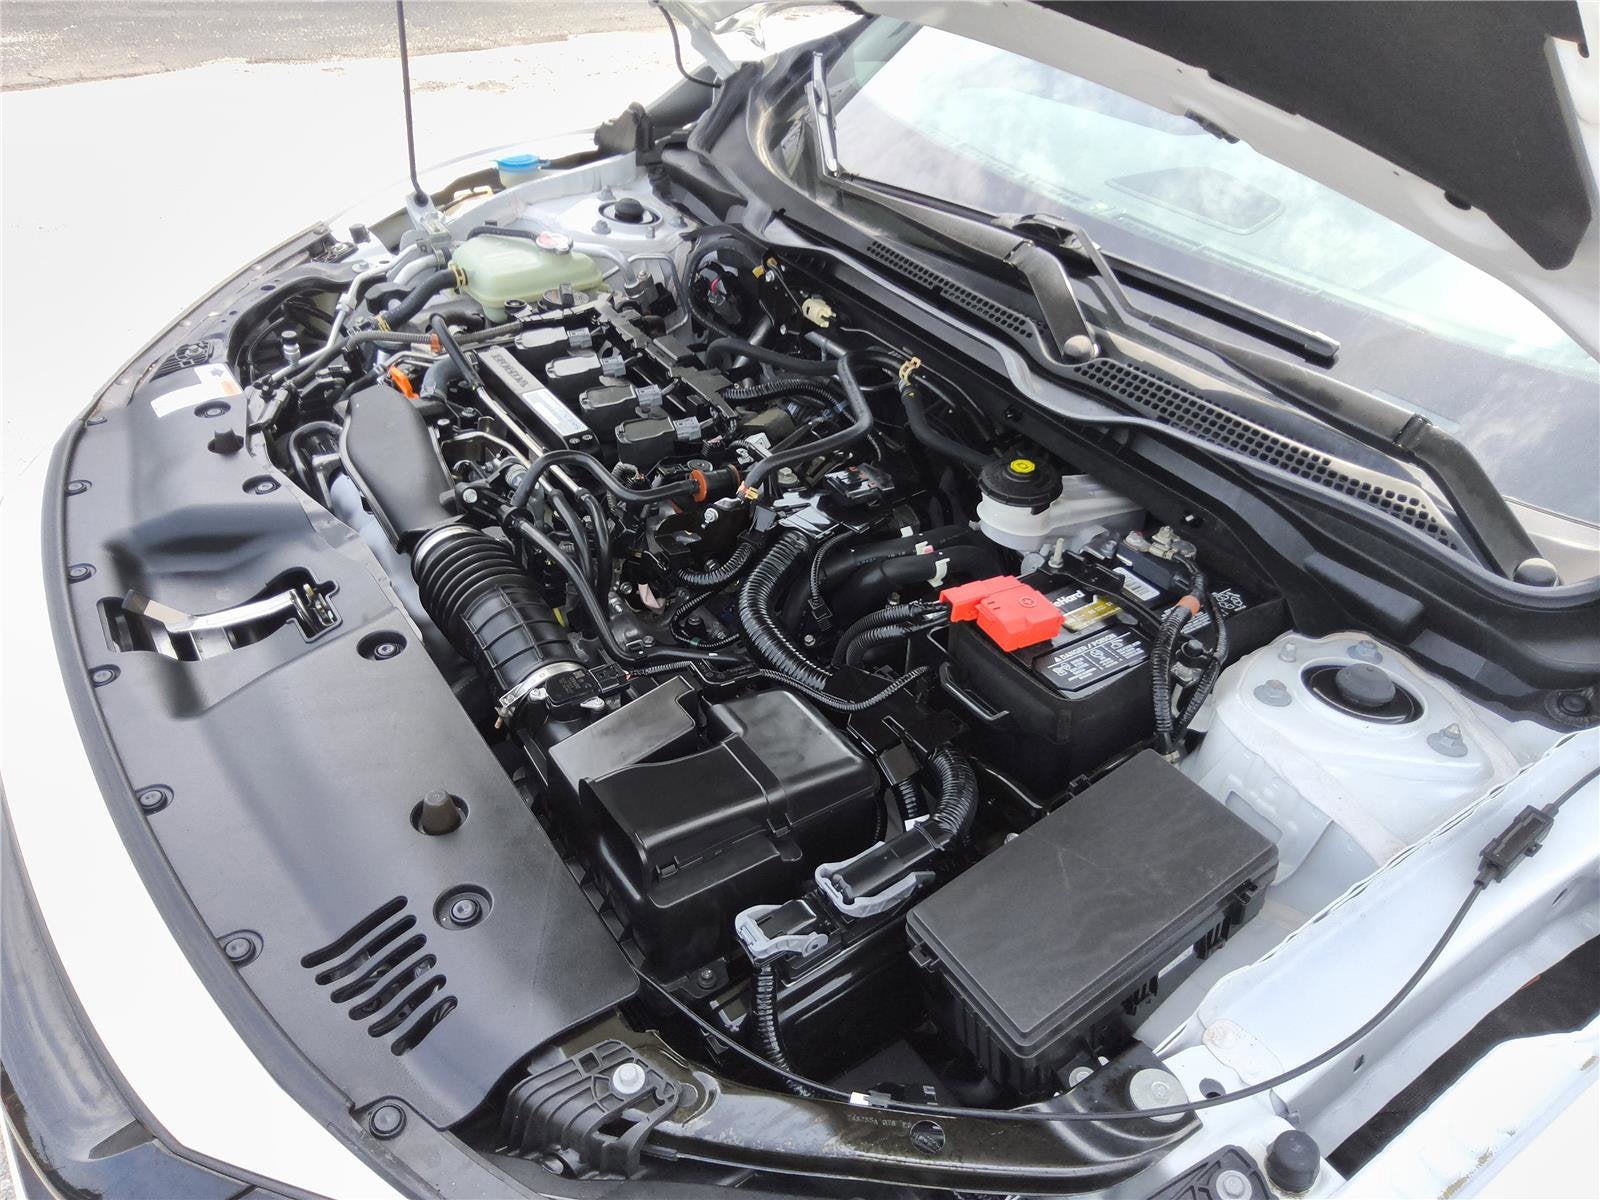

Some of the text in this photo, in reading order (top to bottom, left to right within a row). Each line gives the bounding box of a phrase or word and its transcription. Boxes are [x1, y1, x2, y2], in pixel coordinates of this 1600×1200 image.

[1052, 589, 1085, 607] eHard
[1060, 645, 1087, 660] DANGER
[1092, 633, 1117, 646] POISON
